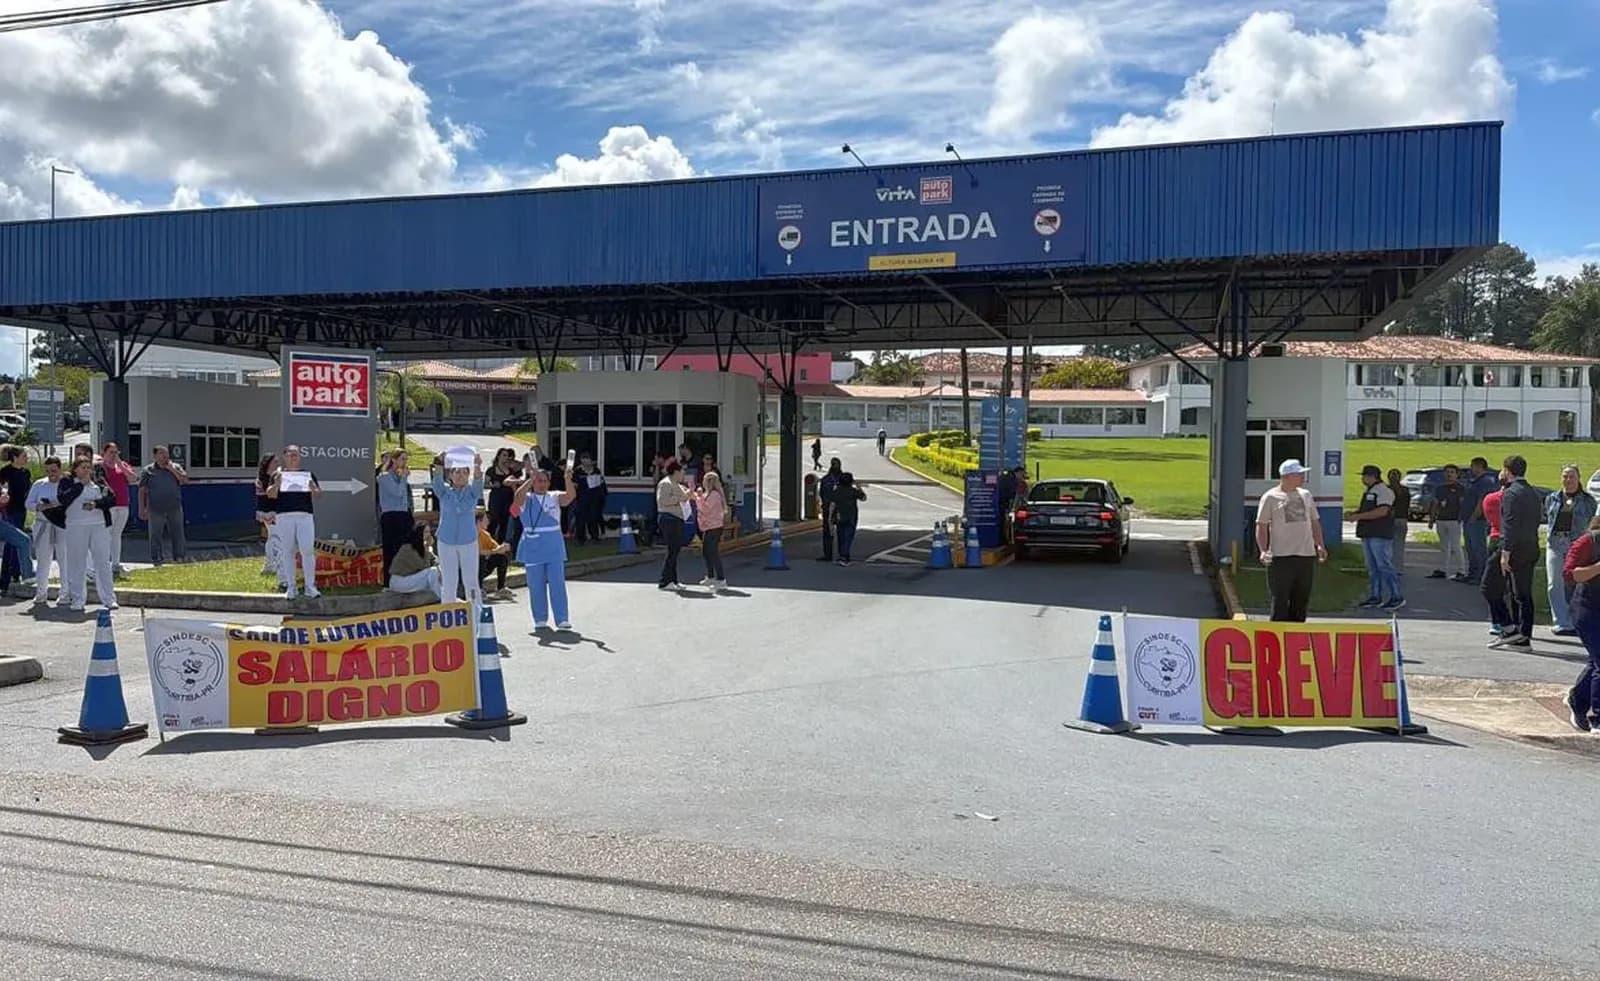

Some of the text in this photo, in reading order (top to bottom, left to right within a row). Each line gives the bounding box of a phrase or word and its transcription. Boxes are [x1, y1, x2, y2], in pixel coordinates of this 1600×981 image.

[922, 189, 949, 201] park
[923, 181, 949, 191] auto
[831, 211, 997, 247] ENTRADA
[297, 363, 361, 385] auto
[296, 383, 362, 407] park
[300, 446, 369, 458] STACIONE
[315, 614, 418, 643] LUTANDO
[425, 608, 468, 630] POR
[163, 632, 209, 648] SINDESC
[1143, 631, 1183, 646] SINDESC
[237, 638, 466, 686] SALÁRIO
[1204, 627, 1398, 719] GREVE
[267, 679, 442, 725] DIGNO
